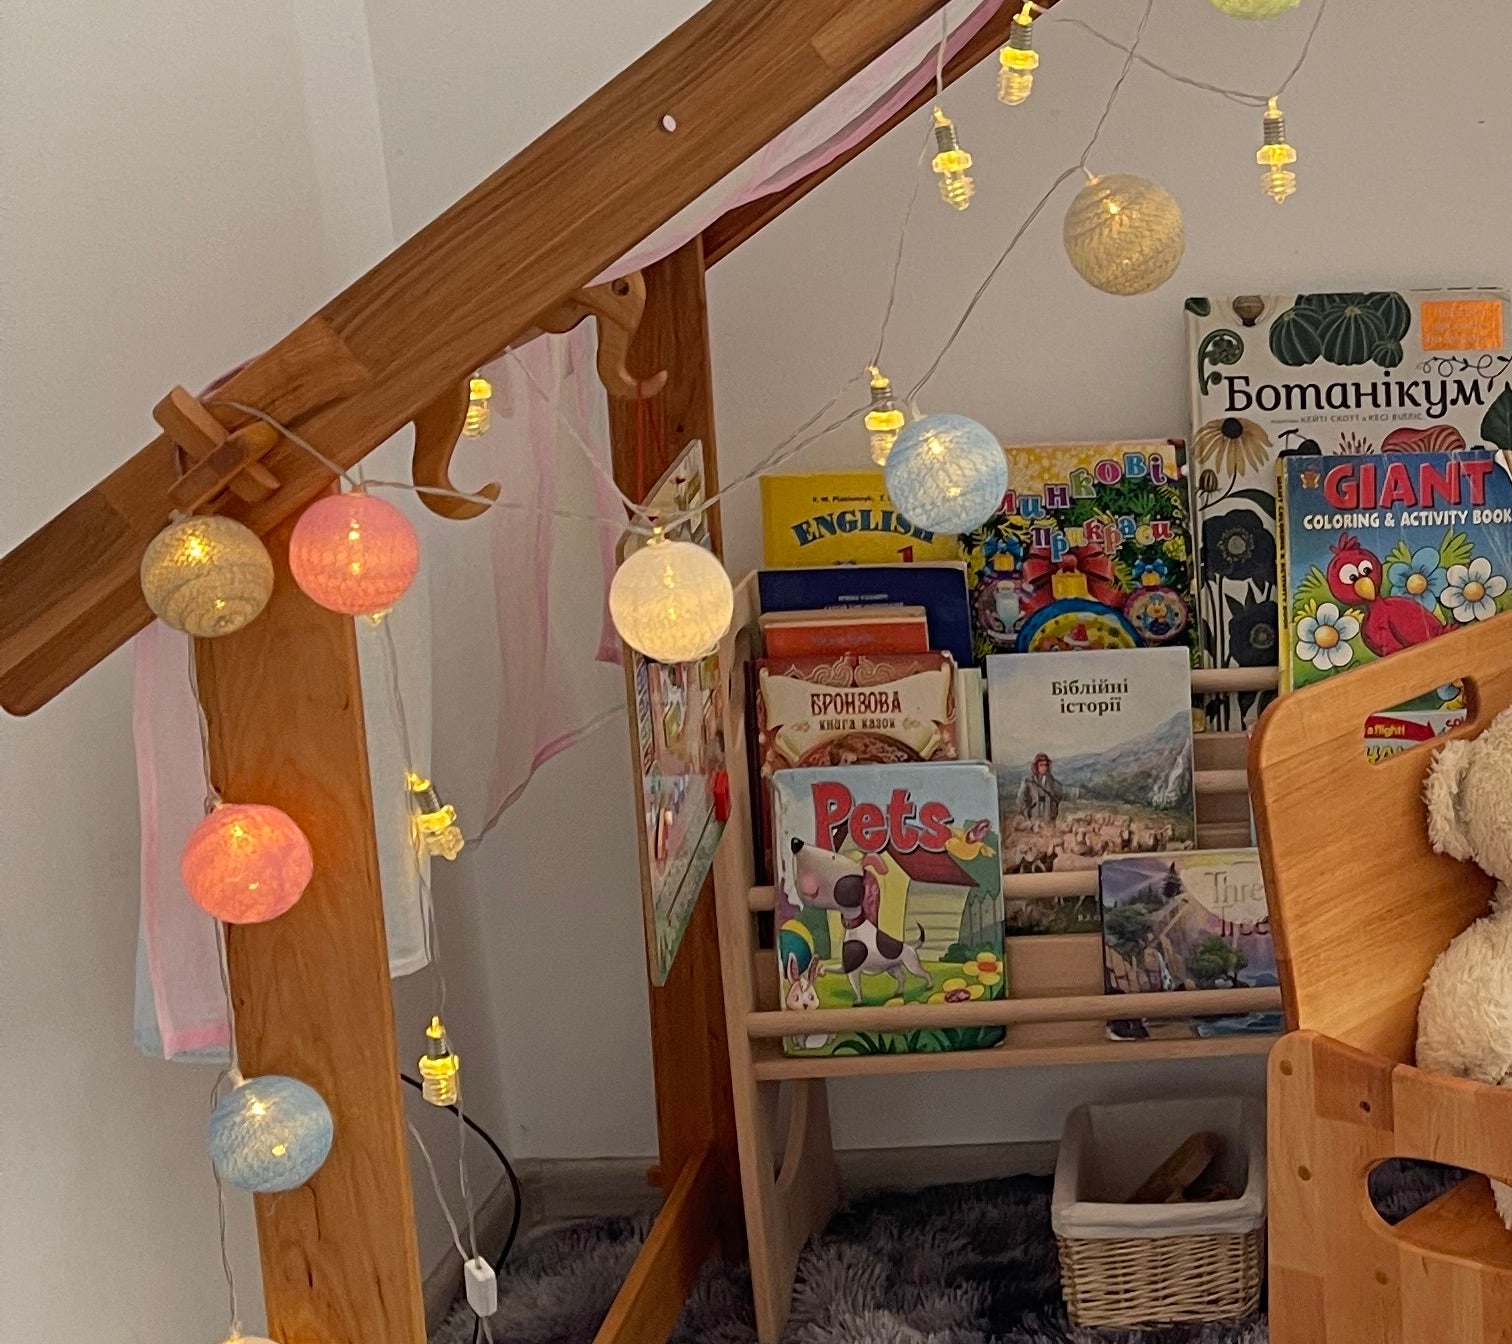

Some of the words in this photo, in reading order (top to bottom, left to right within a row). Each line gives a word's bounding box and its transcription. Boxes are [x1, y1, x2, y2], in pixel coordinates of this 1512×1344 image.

[1223, 370, 1485, 419] Ботанікум
[1322, 459, 1494, 510] GIANT
[1302, 512, 1380, 530] COLORING
[1384, 511, 1395, 527] &
[1400, 509, 1469, 527] ACTIVITY
[1472, 507, 1512, 525] BOOK
[1051, 678, 1129, 696] Біблійні
[810, 690, 902, 716] БРОНЗОВА
[1060, 697, 1122, 717] історії
[811, 781, 955, 853] Pets
